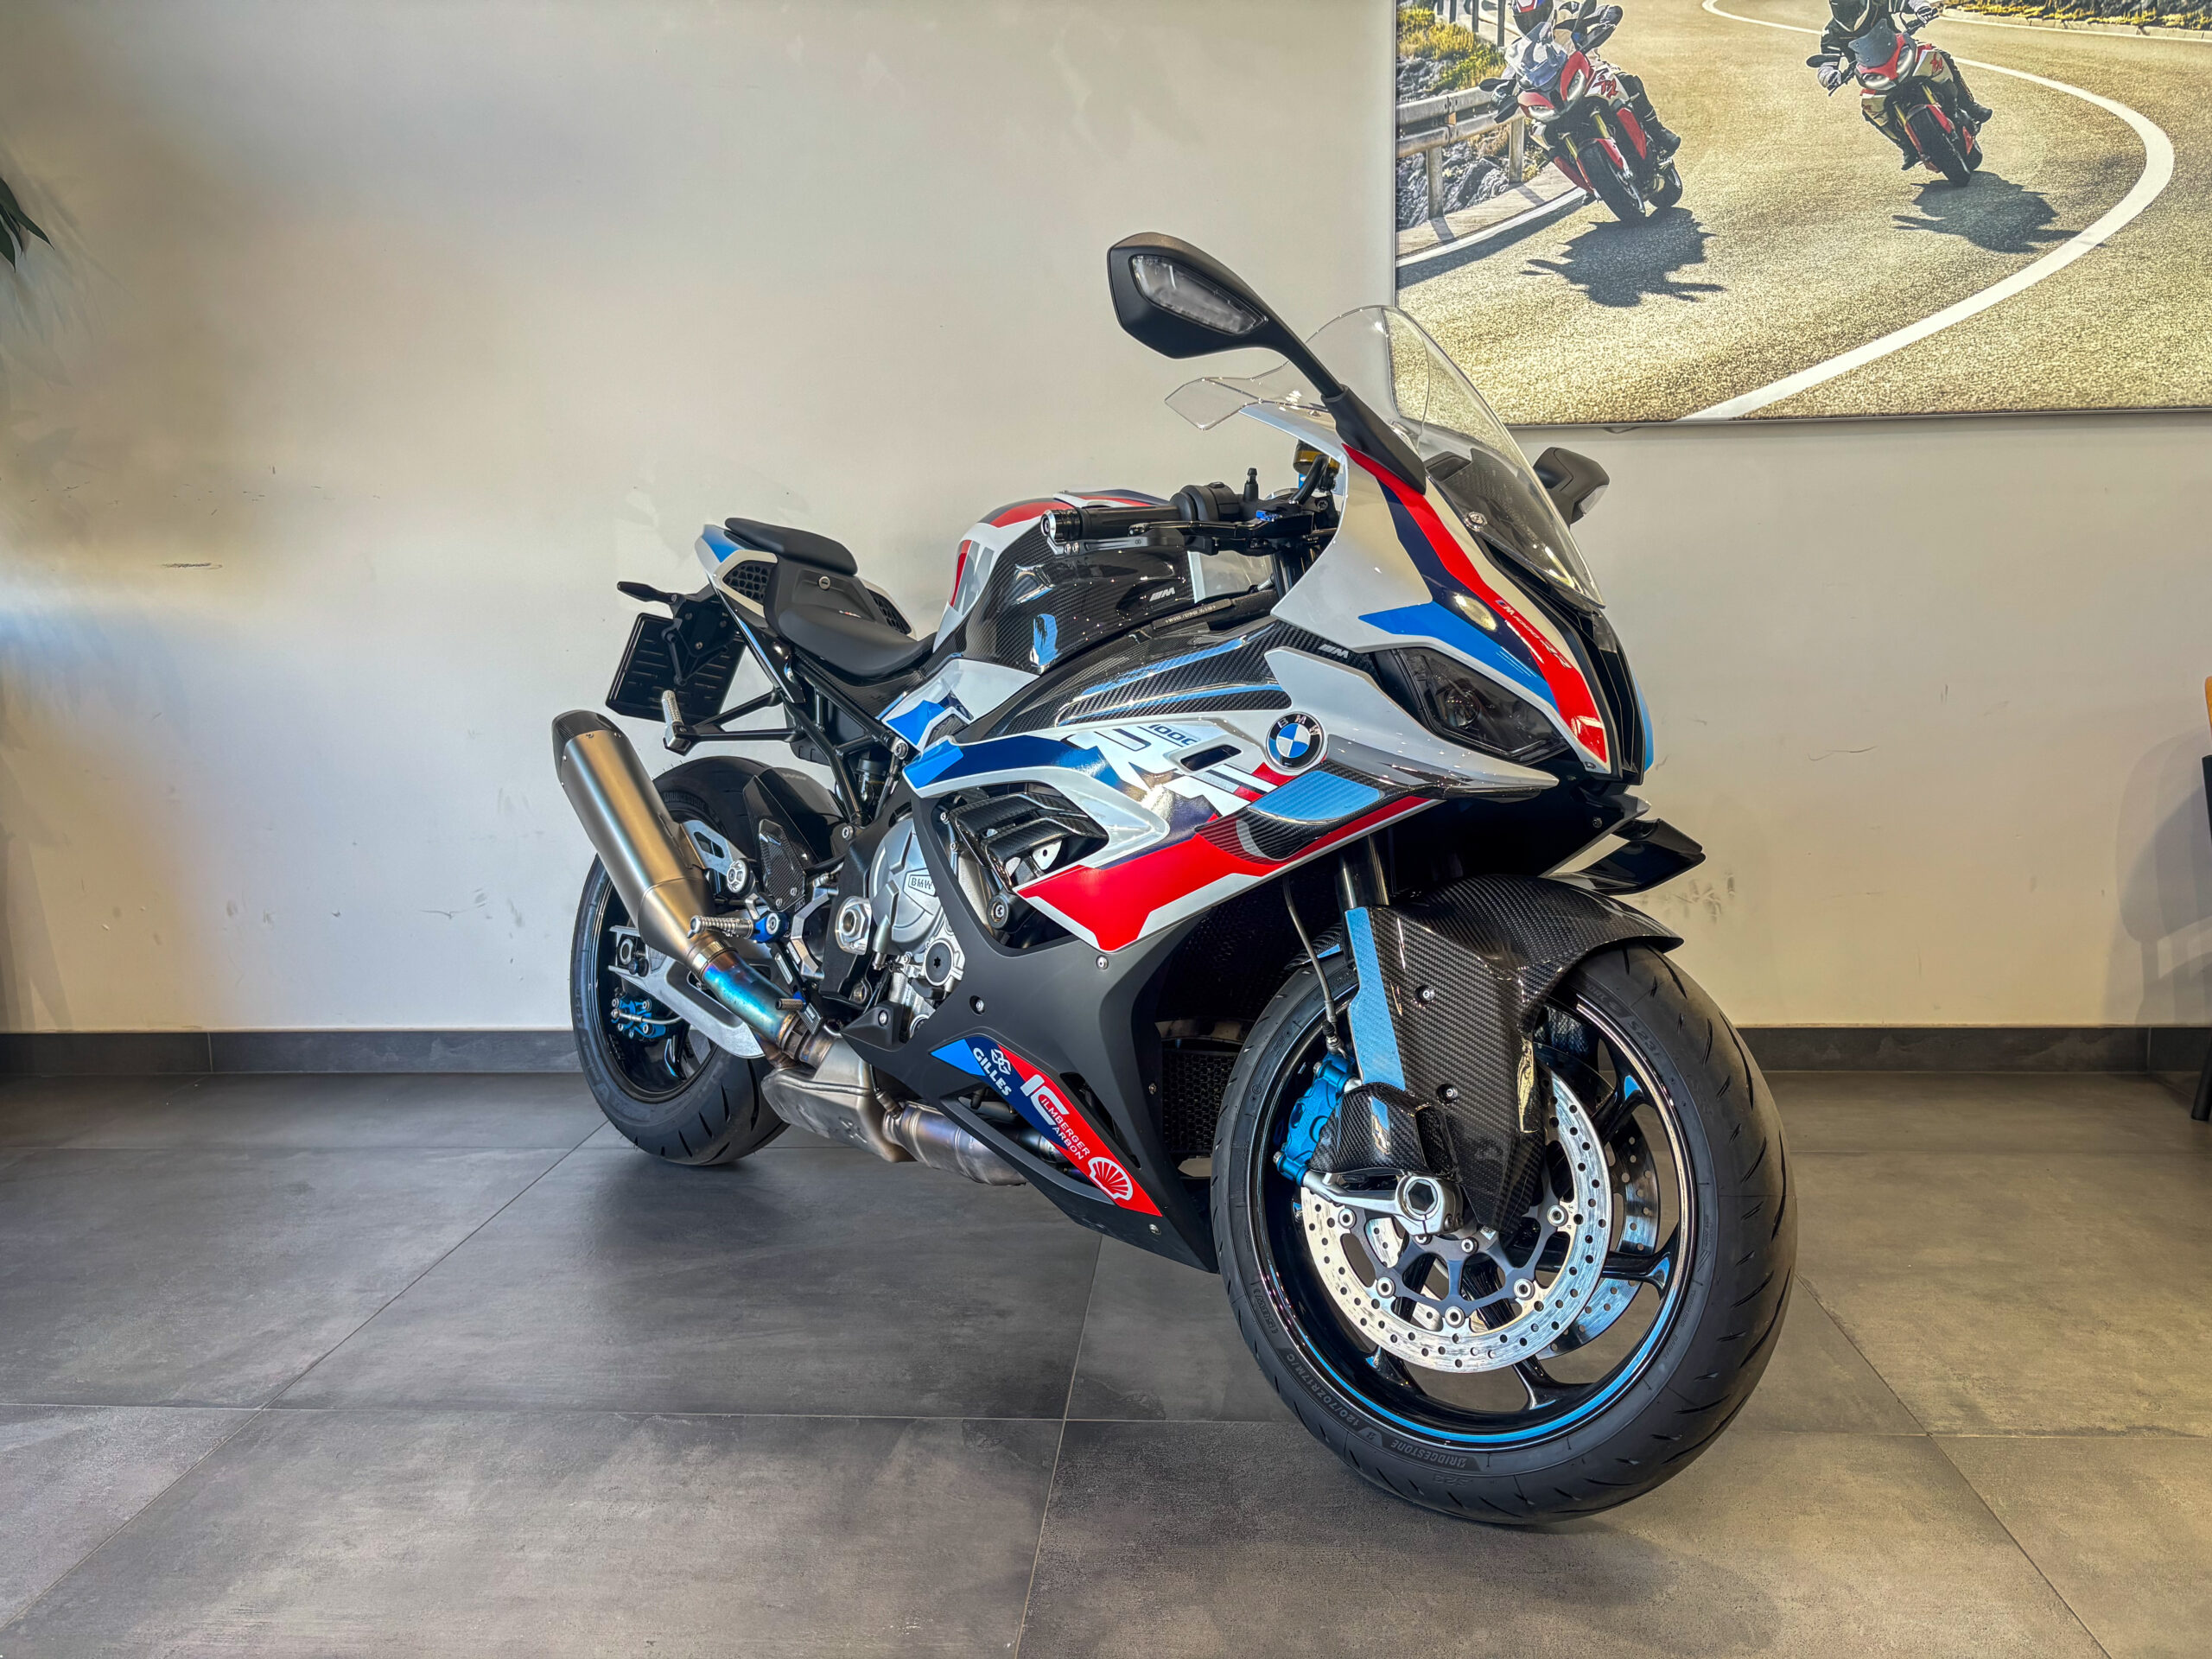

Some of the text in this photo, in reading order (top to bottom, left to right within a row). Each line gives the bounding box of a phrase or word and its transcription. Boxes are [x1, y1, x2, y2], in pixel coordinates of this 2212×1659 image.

[1277, 714, 1321, 736] BMW
[911, 878, 934, 890] BMW
[973, 1047, 1012, 1096] GILLES
[1040, 1098, 1090, 1156] ILMBERGER
[1390, 1440, 1468, 1469] BRIDGESTONE
